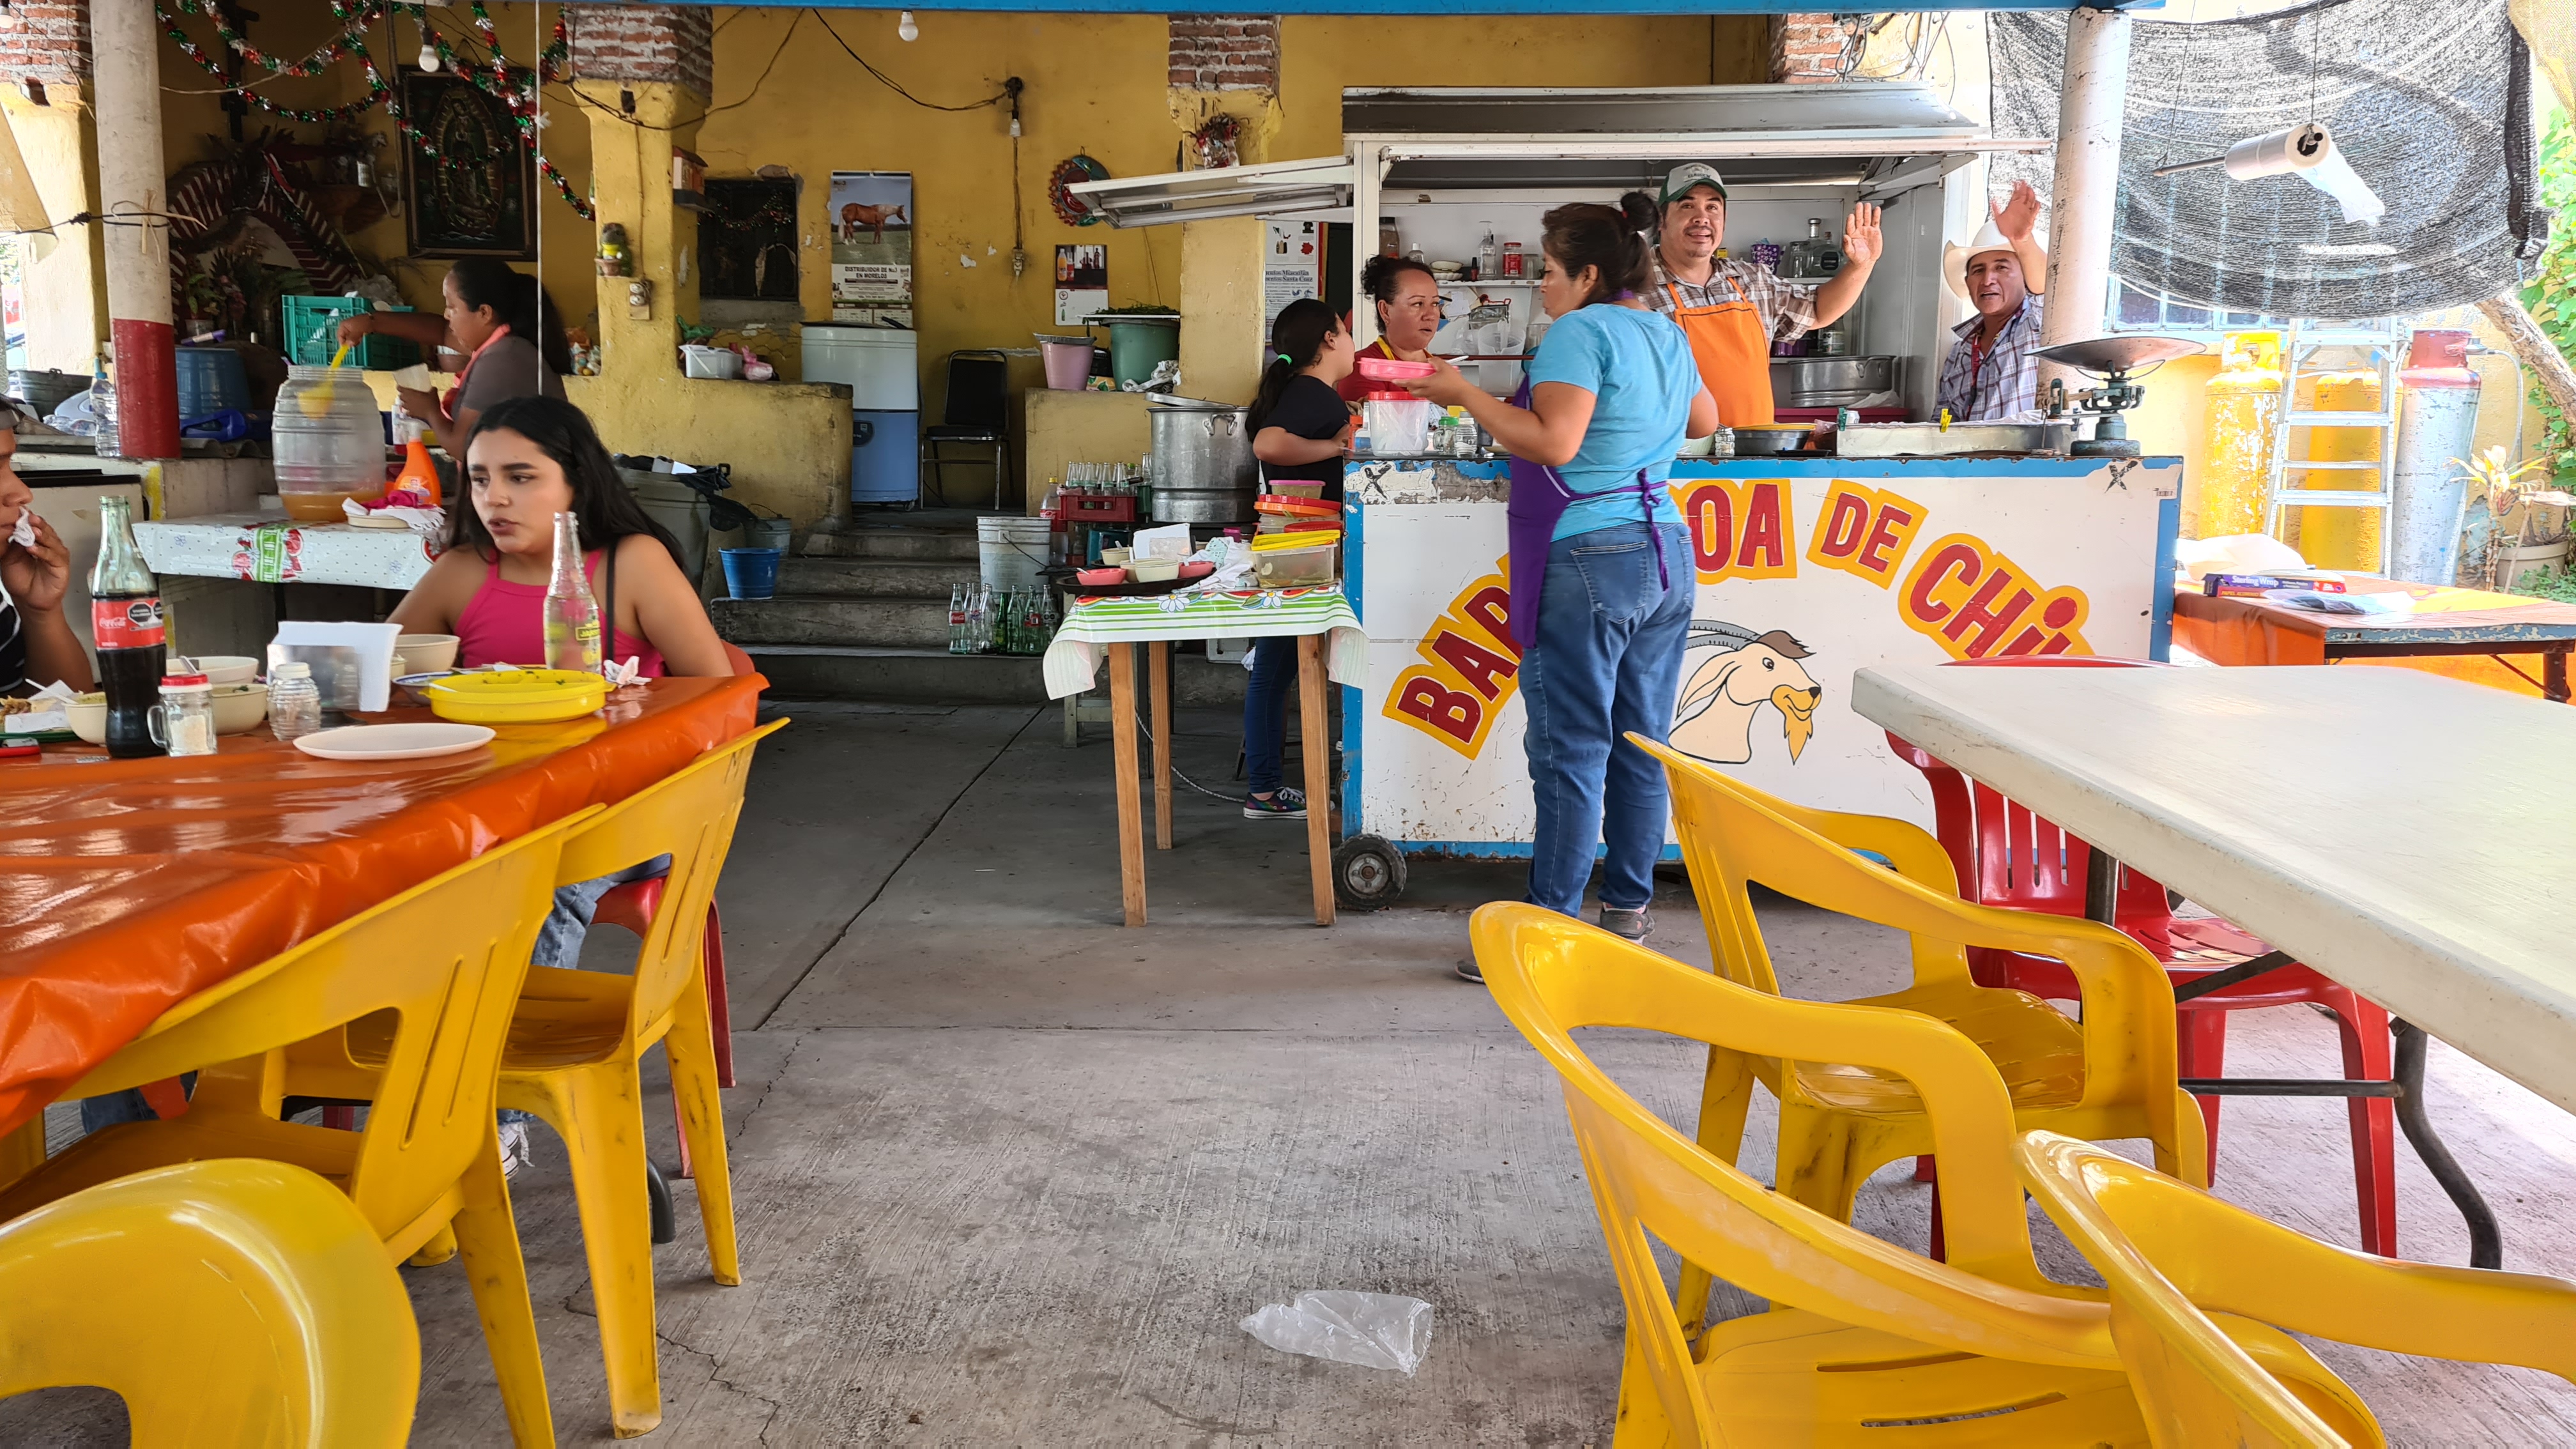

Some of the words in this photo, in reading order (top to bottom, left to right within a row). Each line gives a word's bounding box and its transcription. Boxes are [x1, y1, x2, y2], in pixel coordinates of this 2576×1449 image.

[1821, 493, 1912, 573] DE
[2232, 575, 2260, 586] Sterling
[2259, 576, 2280, 587] Wrap
